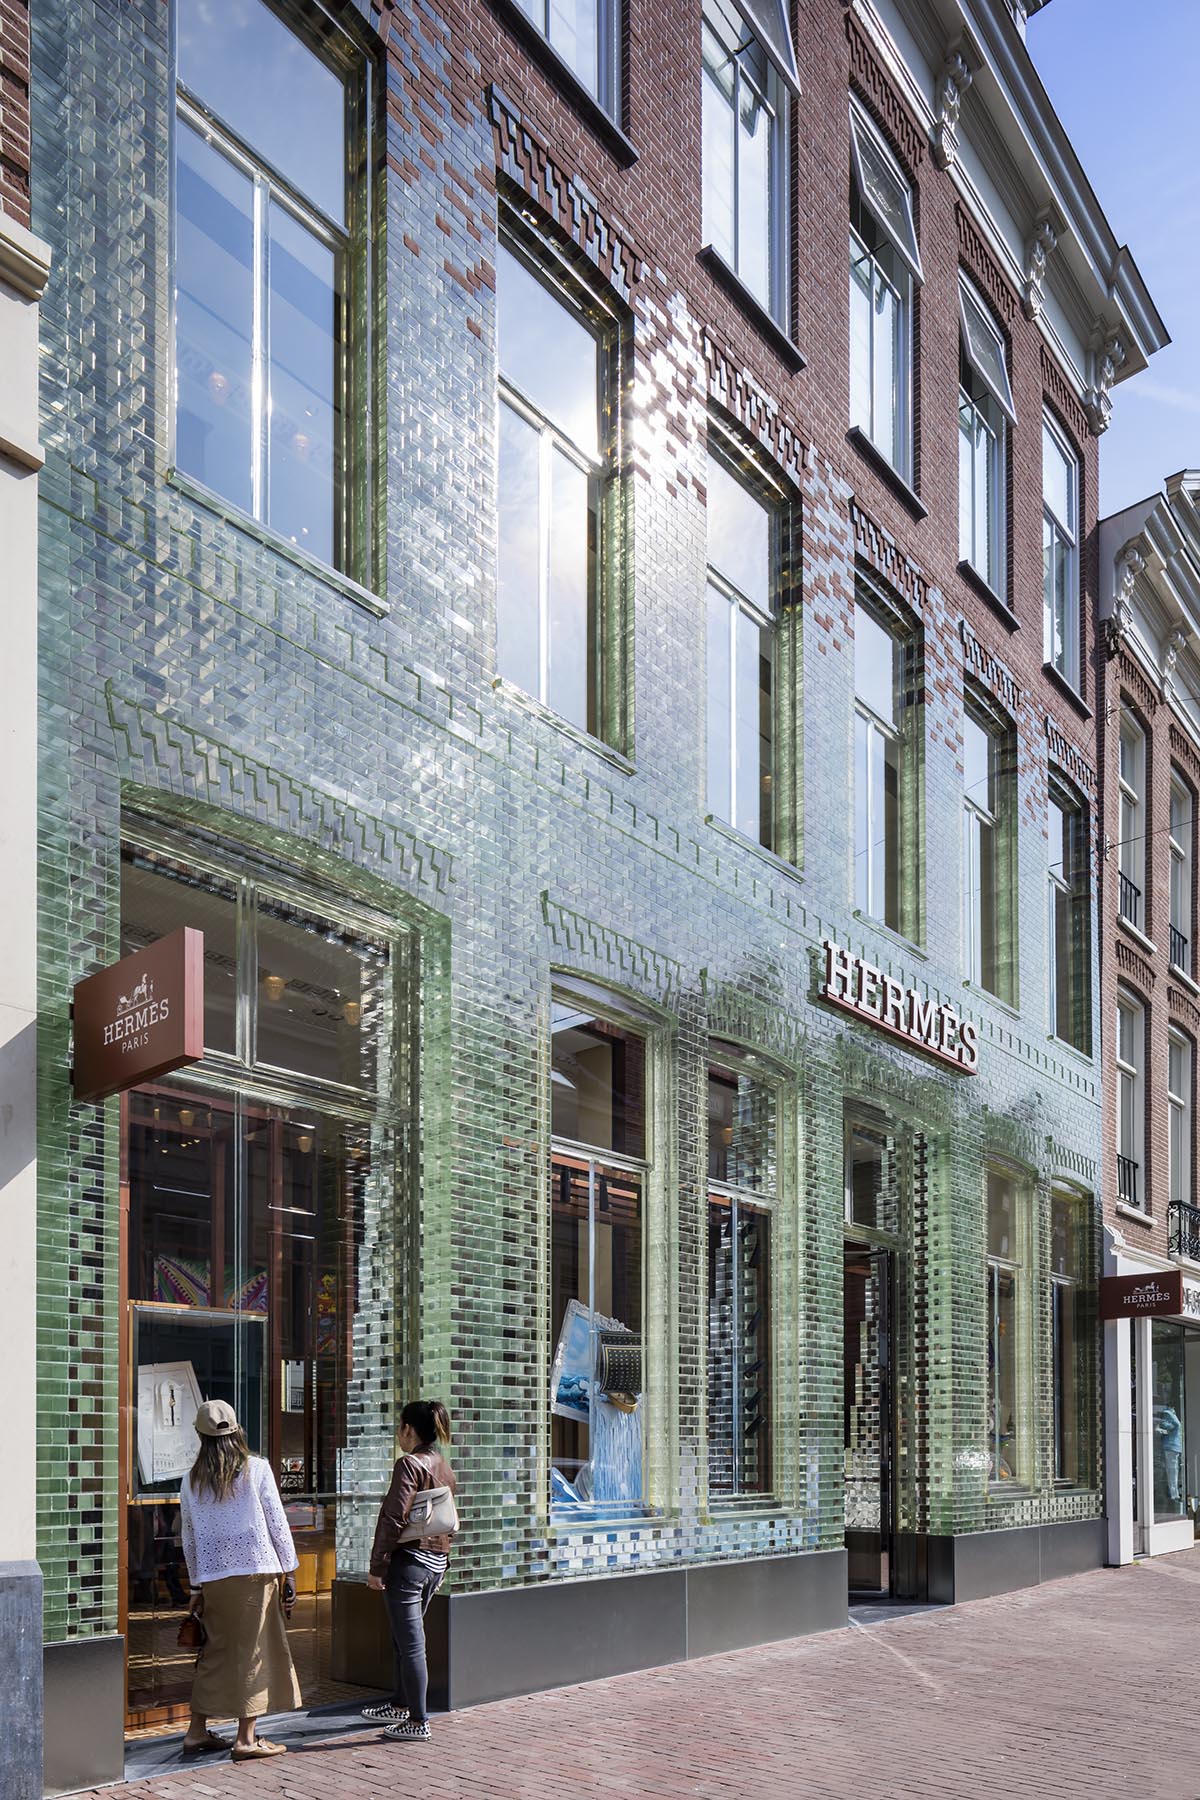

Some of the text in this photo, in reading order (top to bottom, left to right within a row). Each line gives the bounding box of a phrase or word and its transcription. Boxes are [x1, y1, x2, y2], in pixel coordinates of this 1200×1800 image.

[823, 940, 978, 1067] HERMÈS
[103, 999, 169, 1045] HERMÈS
[121, 1033, 149, 1054] PARIS
[1123, 1292, 1170, 1304] HERMÈS
